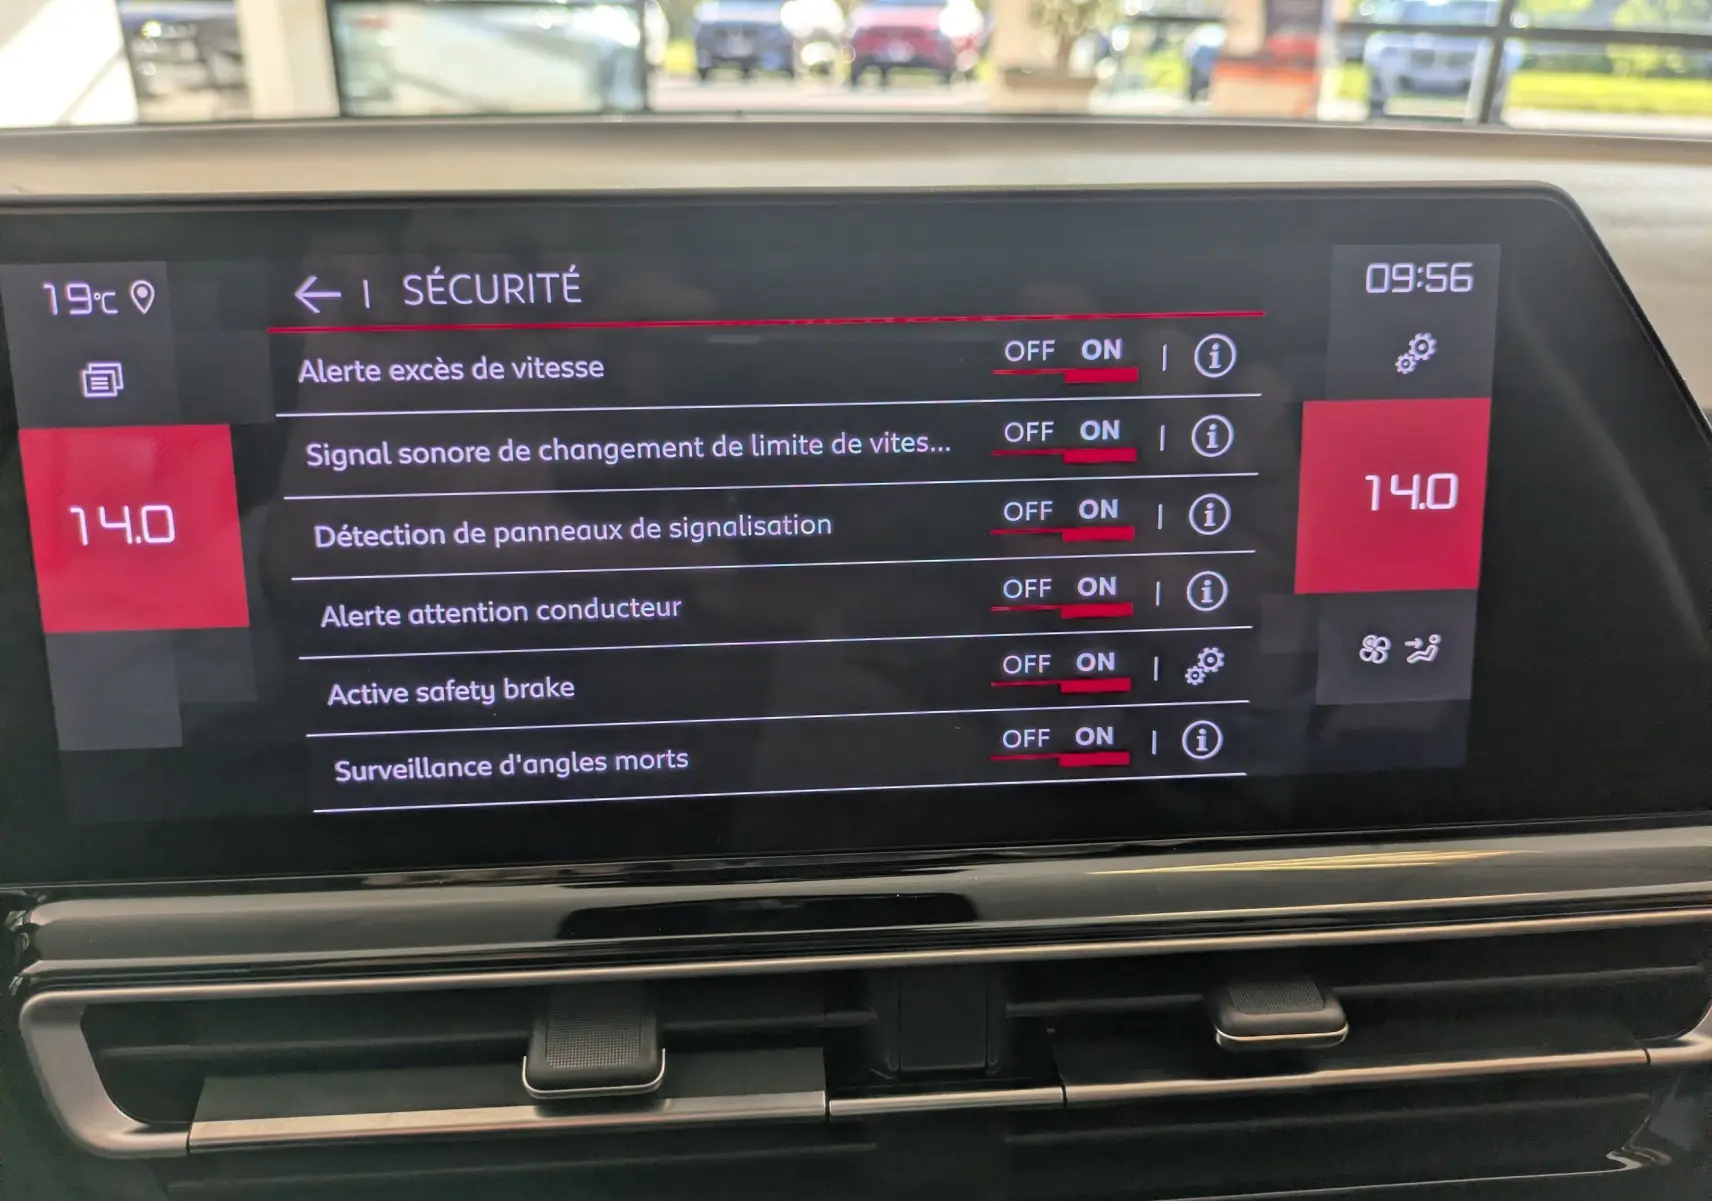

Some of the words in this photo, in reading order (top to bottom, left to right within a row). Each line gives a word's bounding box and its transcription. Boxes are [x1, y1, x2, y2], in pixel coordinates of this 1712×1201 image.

[402, 263, 582, 306] SÉCURITÉ
[1365, 261, 1474, 294] 09:56
[1004, 339, 1056, 362] OFF
[1081, 338, 1122, 361] ON
[298, 357, 382, 384] Alerte
[388, 356, 465, 382] excès
[471, 355, 505, 381] de
[511, 355, 605, 379] vitesse
[1004, 421, 1055, 443] OFF
[1079, 419, 1120, 441] ON
[306, 440, 391, 472] Signal
[397, 445, 491, 465] sonore
[497, 438, 531, 463] de
[538, 436, 705, 466] changement
[711, 433, 744, 458] de
[751, 433, 824, 457] limite
[831, 431, 863, 455] de
[1364, 472, 1459, 512] 14.0
[69, 504, 176, 546] 14.0
[1003, 500, 1053, 522] OFF
[1078, 498, 1119, 520] ON
[313, 523, 446, 549] Détection
[452, 520, 487, 545] de
[493, 523, 624, 549] panneaux
[629, 516, 662, 540] de
[669, 513, 832, 544] signalisation
[1002, 578, 1053, 599] OFF
[1077, 576, 1117, 597] ON
[320, 603, 401, 628] Alerte
[407, 600, 529, 625] attention
[535, 596, 682, 621] conducteur
[1002, 654, 1052, 675] OFF
[1076, 651, 1116, 672] ON
[327, 682, 408, 706] Active
[415, 678, 496, 706] safety
[503, 675, 575, 700] brake
[1002, 728, 1051, 749] OFF
[1075, 726, 1114, 746] ON
[334, 756, 493, 783] Surveillance
[498, 750, 608, 779] d'angles
[615, 749, 689, 771] morts
